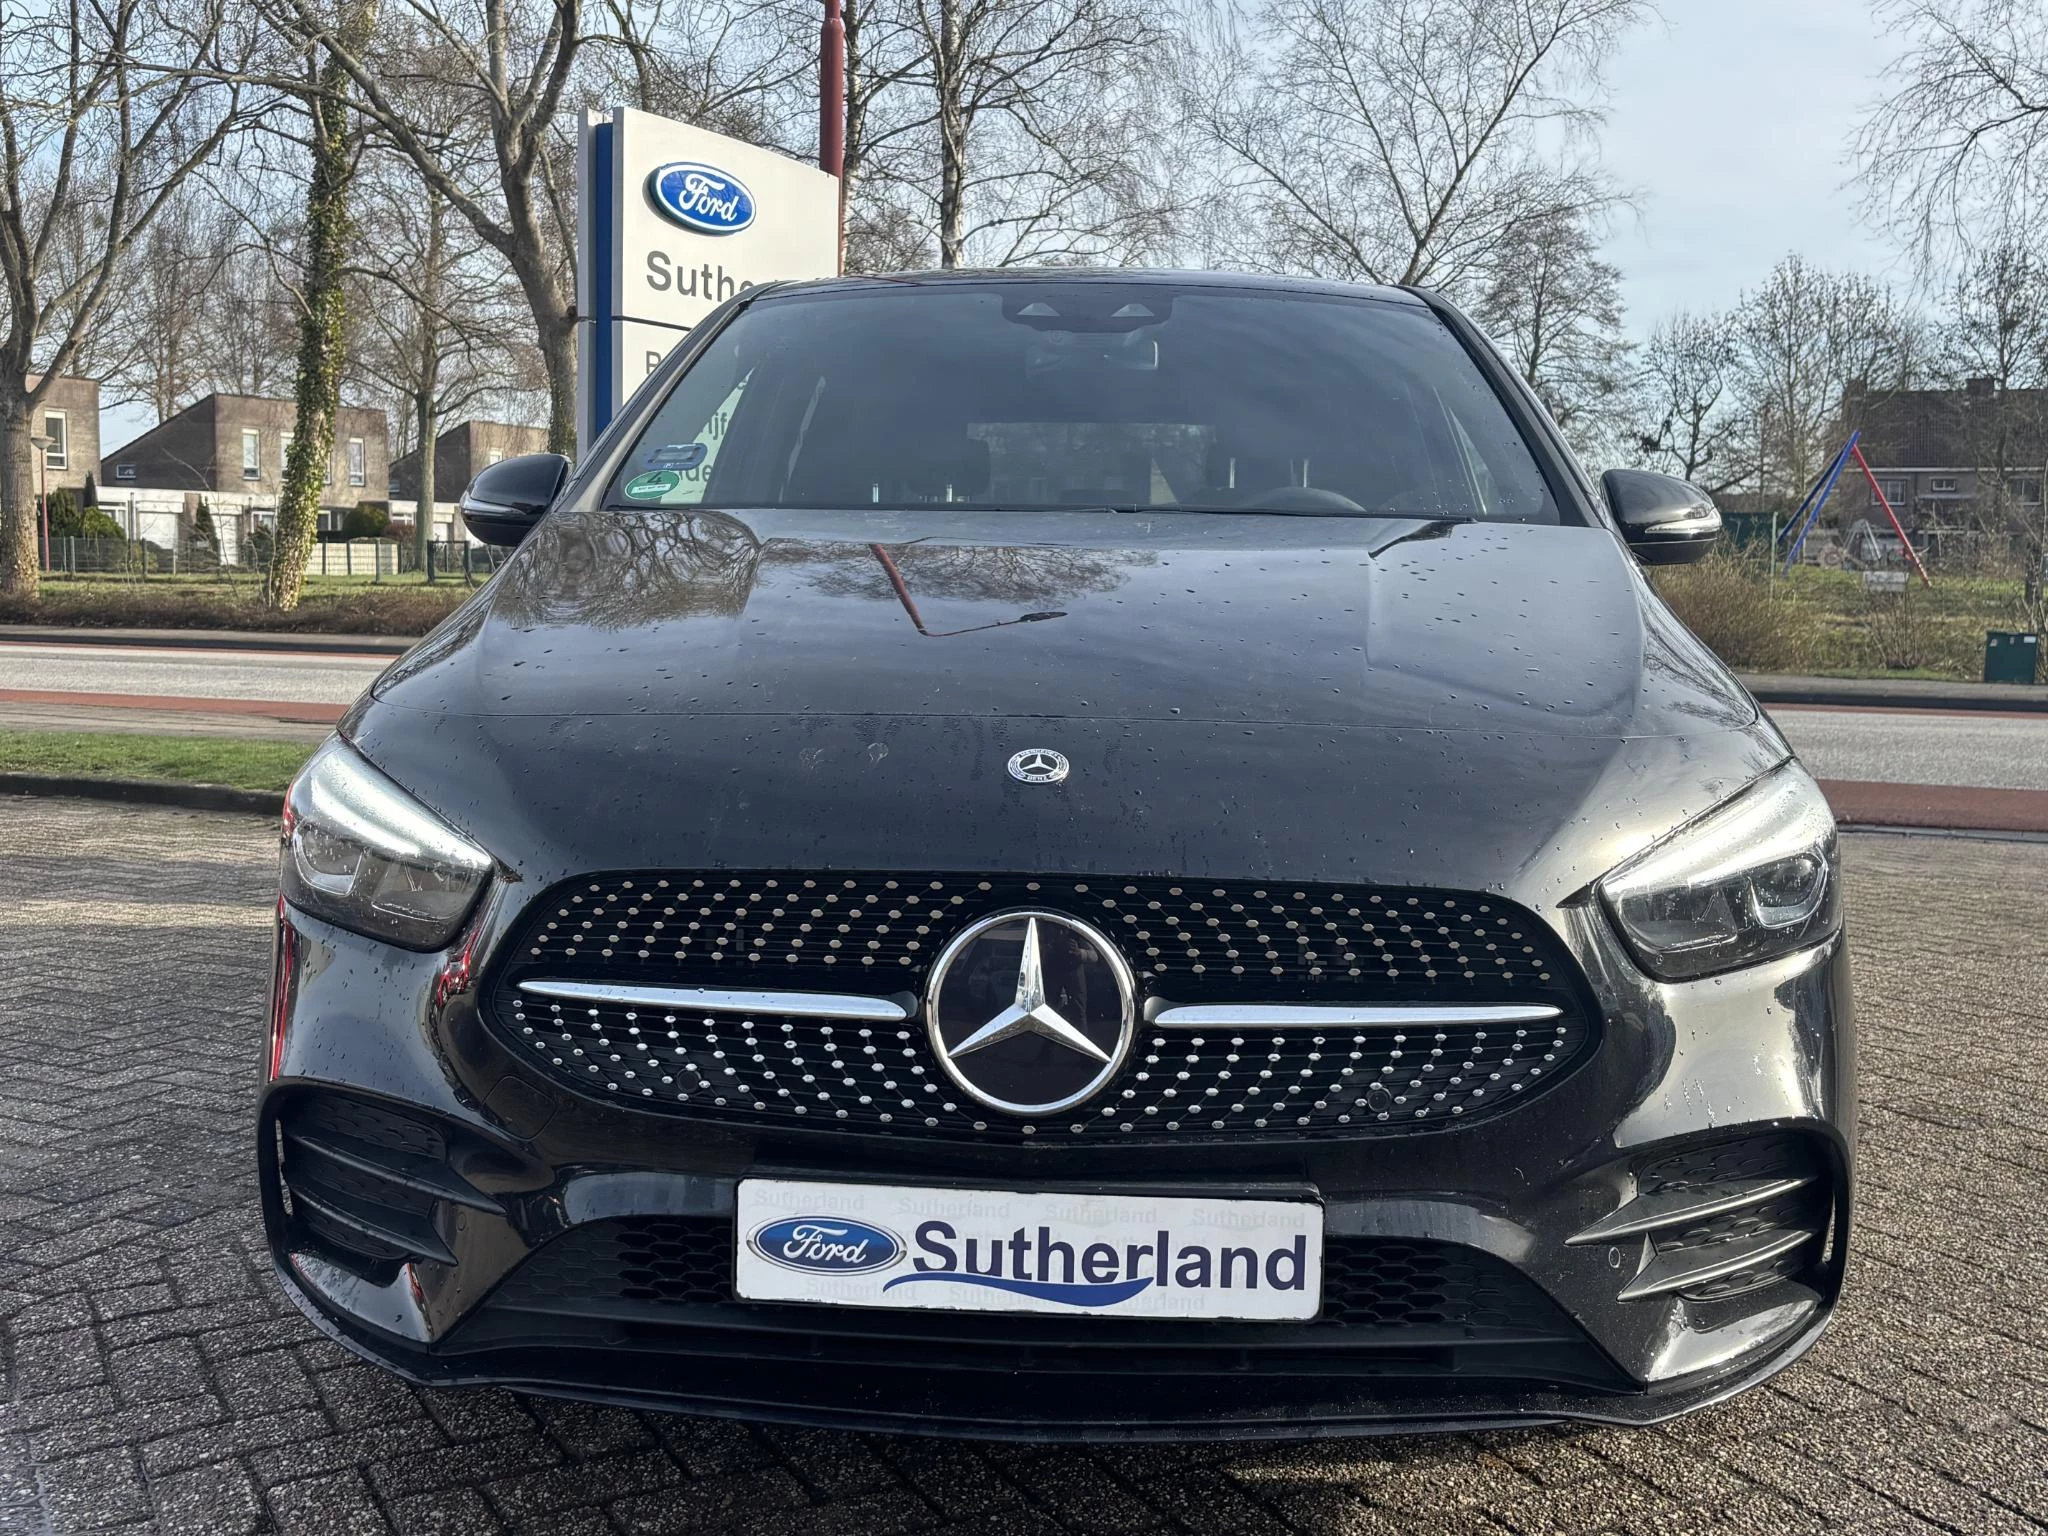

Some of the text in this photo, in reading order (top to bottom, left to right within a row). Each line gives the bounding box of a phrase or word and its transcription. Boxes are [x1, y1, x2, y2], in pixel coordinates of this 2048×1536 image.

[678, 173, 739, 222] Ford
[754, 1188, 1305, 1230] Sutherland Sutherland Sutherland Sutherland
[783, 1224, 867, 1265] Ford
[912, 1220, 1307, 1291] Sutherland
